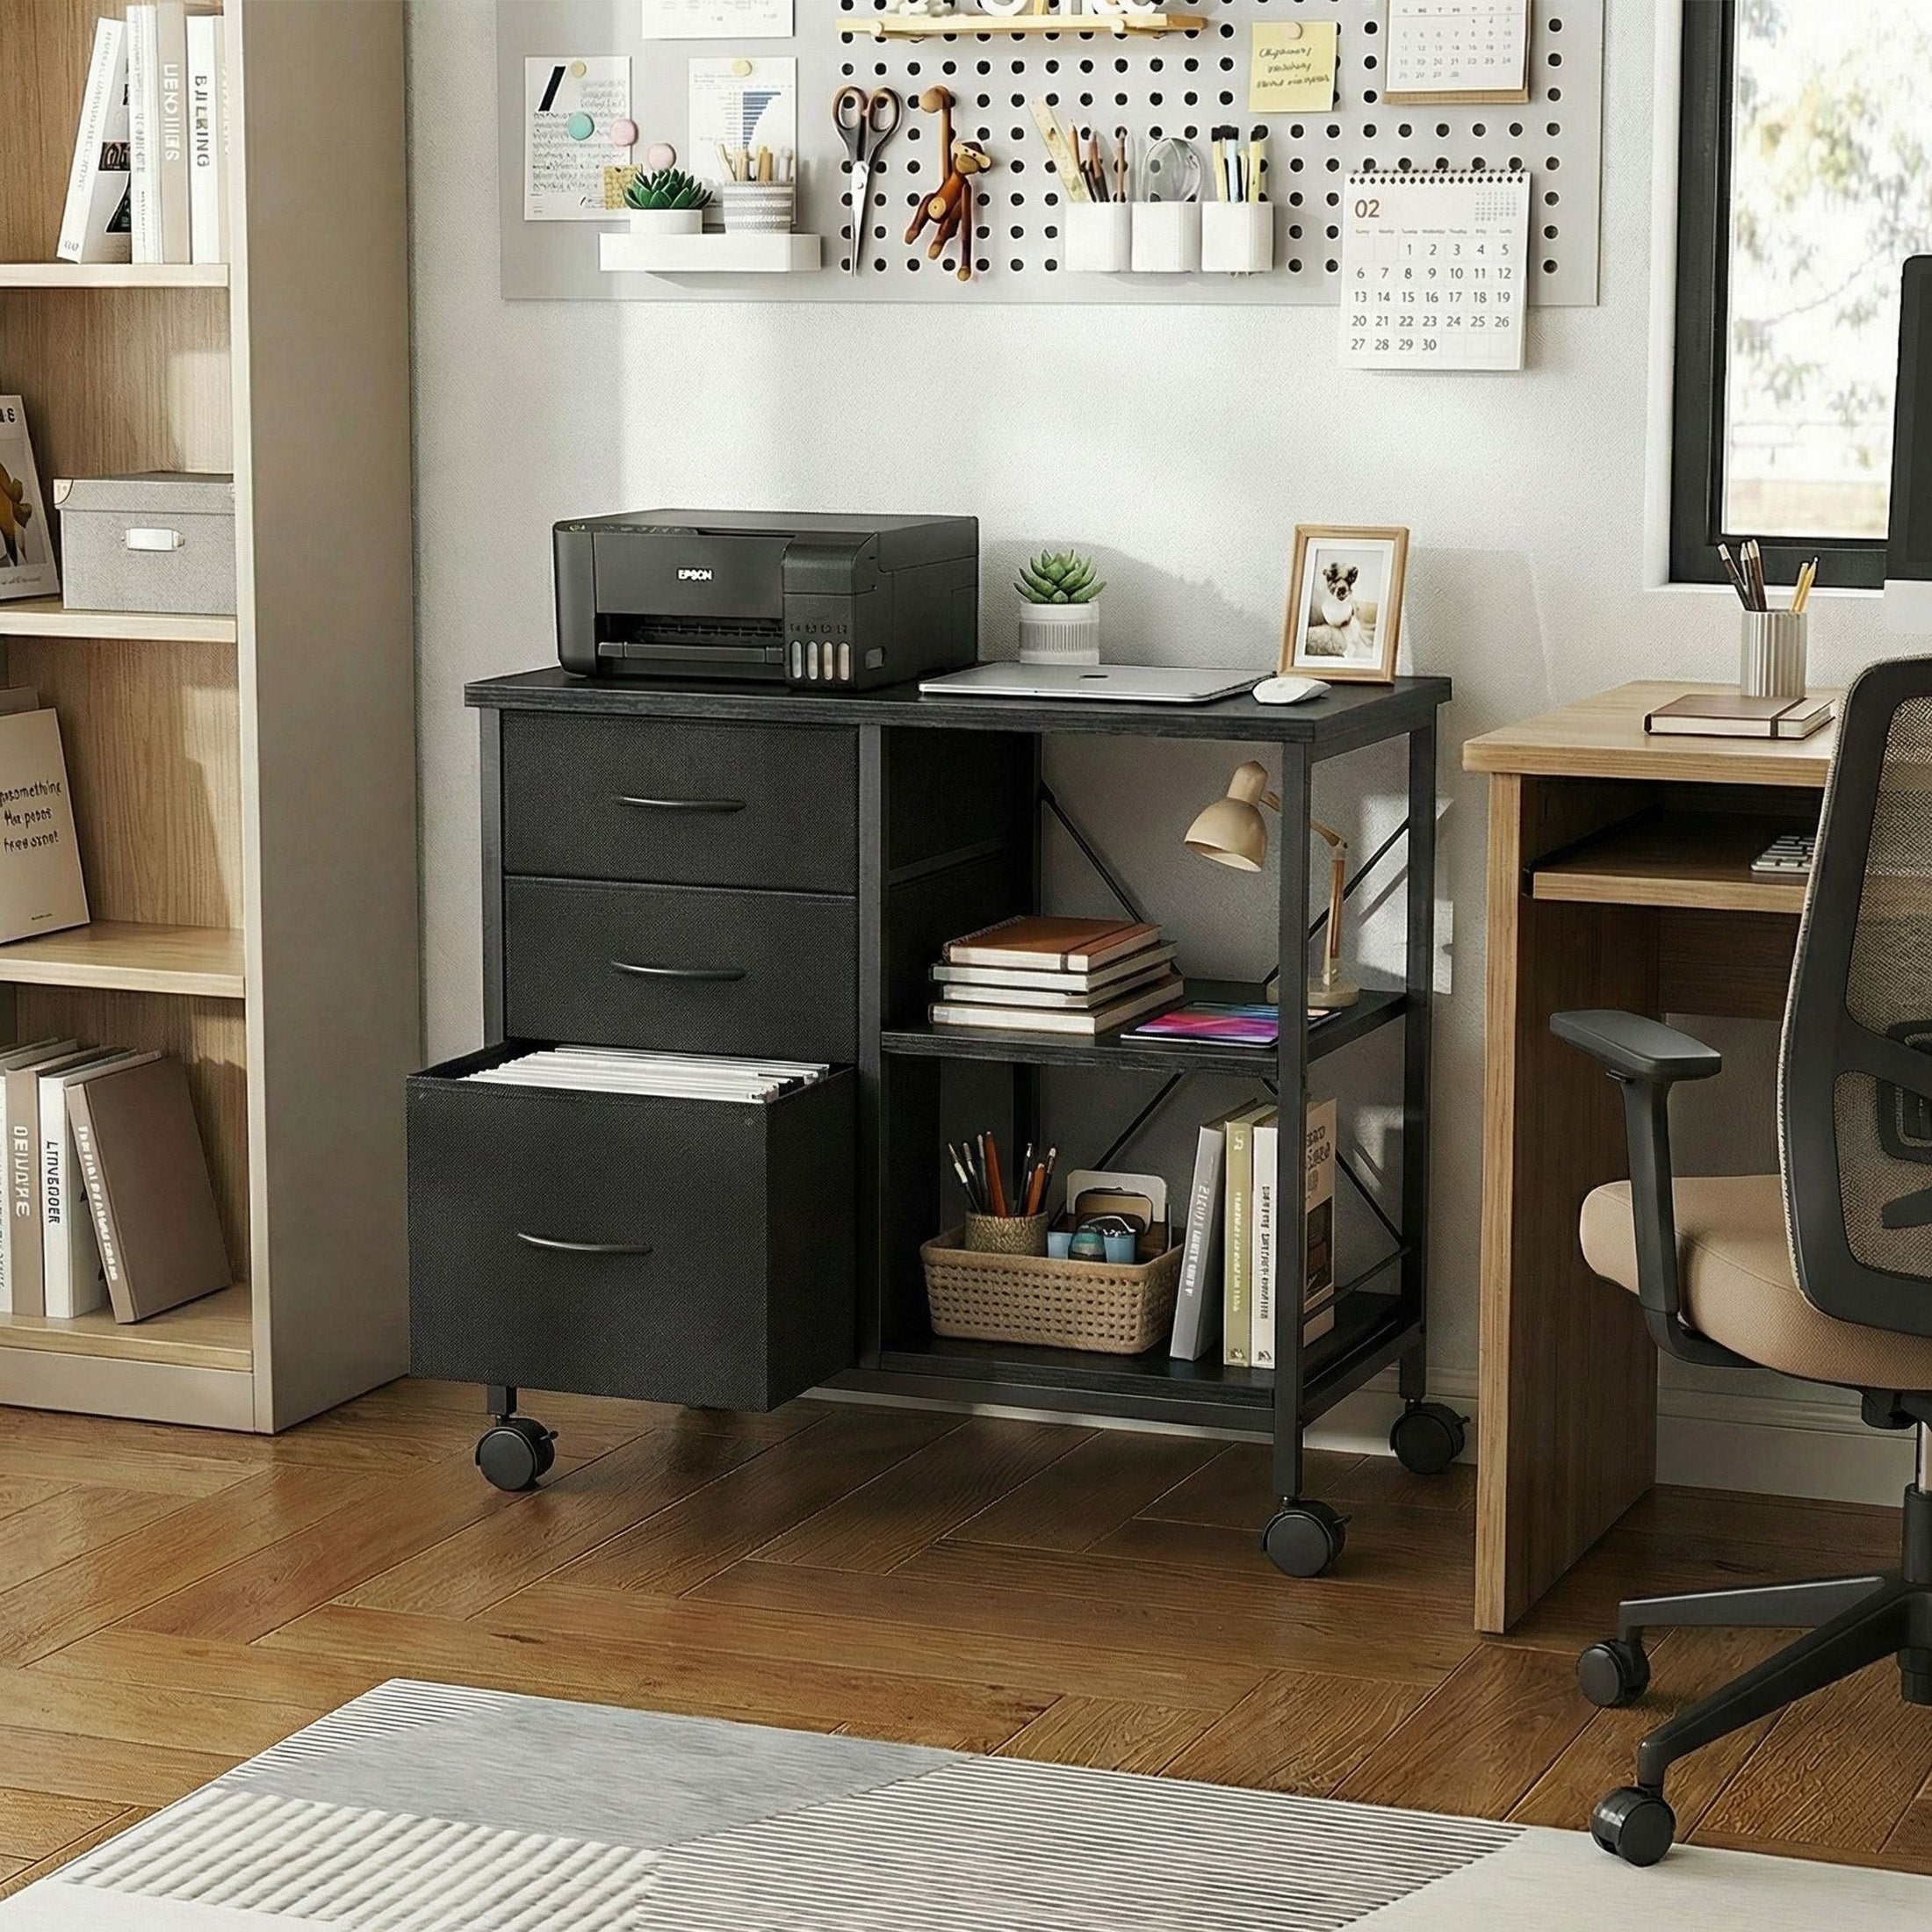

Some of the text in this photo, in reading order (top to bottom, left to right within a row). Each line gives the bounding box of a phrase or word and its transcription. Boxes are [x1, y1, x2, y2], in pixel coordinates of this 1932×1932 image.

[1354, 198, 1381, 219] 02
[1429, 243, 1438, 256] 2
[1453, 243, 1461, 256] 3
[1476, 243, 1485, 256] 4
[1501, 242, 1510, 256] 5
[1356, 266, 1512, 280] 6 7 8 9 10 11 12
[1354, 291, 1511, 304] 13 14 15 16 17 18 19
[1351, 314, 1510, 328] 20 21 22 23 24 25 26
[1351, 337, 1438, 351] 27 28 29 30
[678, 569, 712, 580] EPSON
